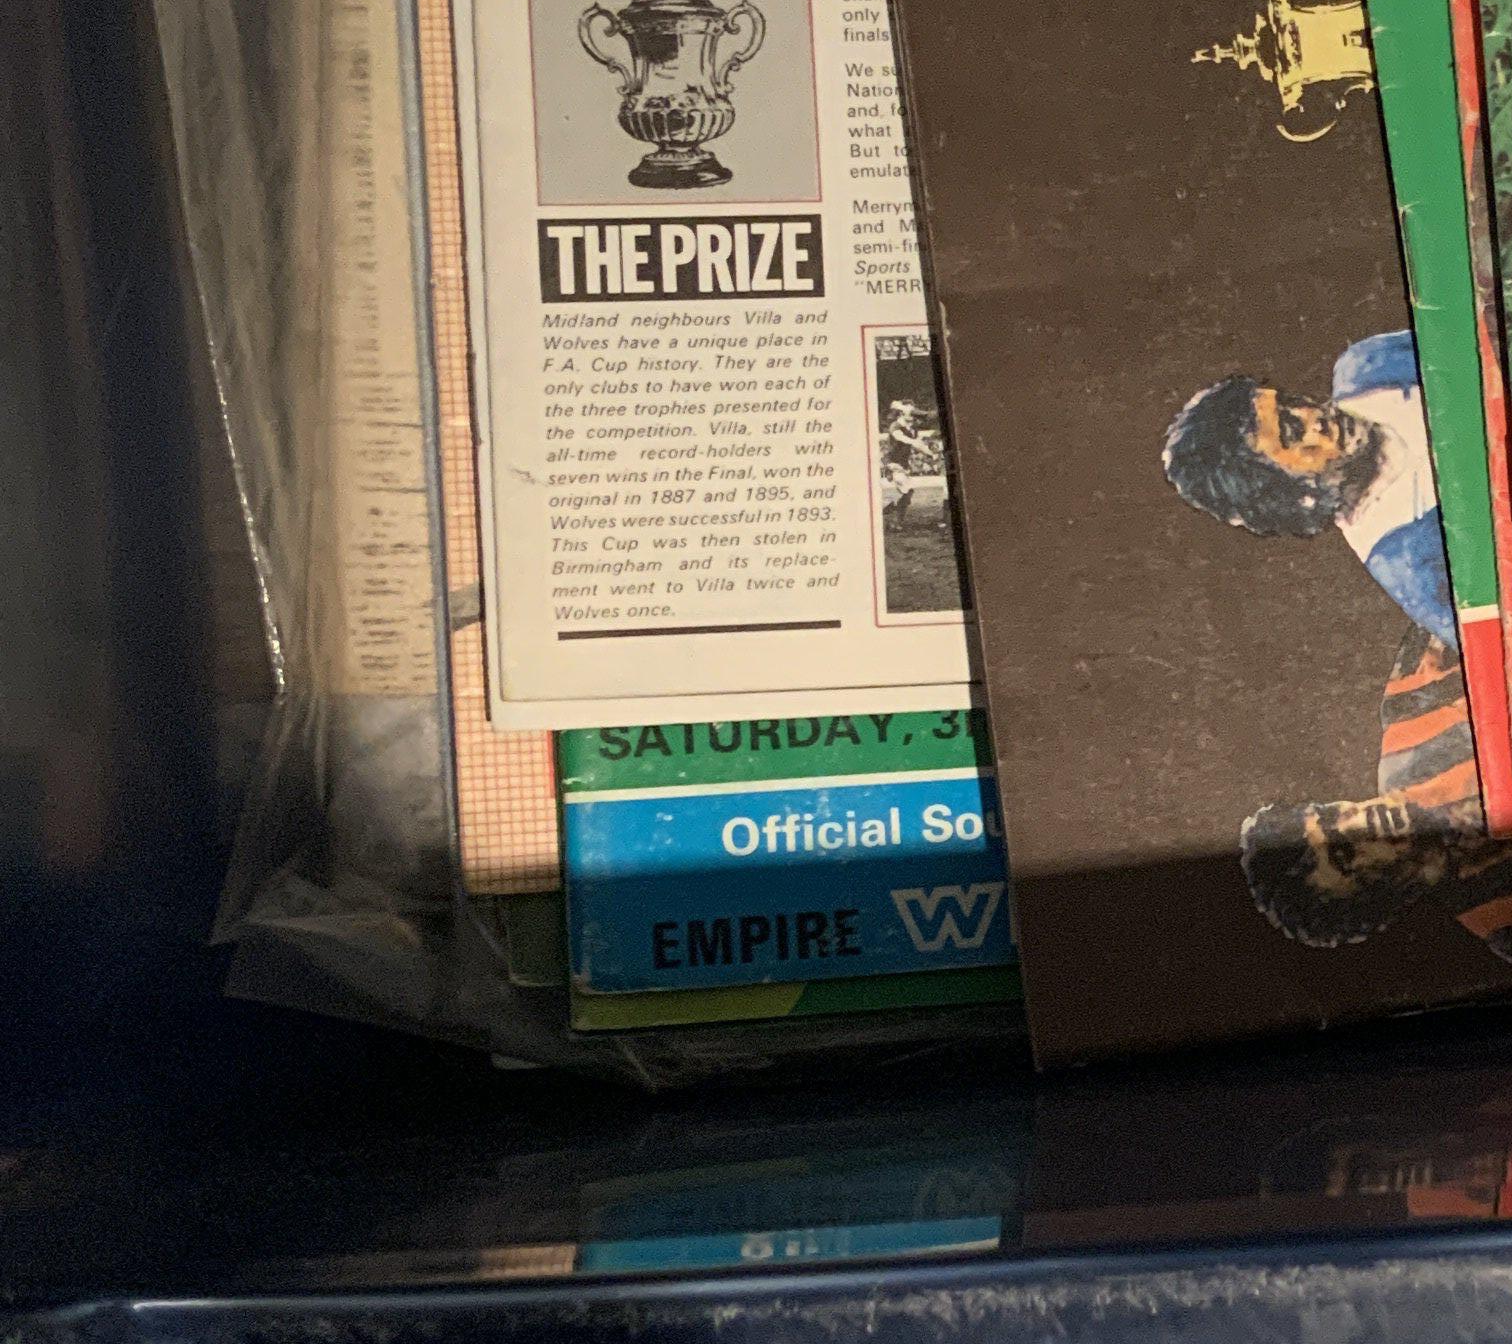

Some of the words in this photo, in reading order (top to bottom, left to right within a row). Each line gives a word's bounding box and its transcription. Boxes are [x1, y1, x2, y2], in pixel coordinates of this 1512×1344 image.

[547, 225, 655, 295] THE
[663, 222, 814, 295] PRIZE
[542, 313, 620, 328] Midland
[631, 312, 731, 330] neighbours
[744, 311, 782, 325] Villa
[795, 310, 828, 324] and
[549, 491, 619, 510] original
[624, 494, 641, 504] in
[652, 489, 696, 504] 1887
[703, 488, 737, 503] and
[803, 485, 837, 499] and
[722, 807, 901, 857] Official
[652, 908, 861, 971] EMPIRE
